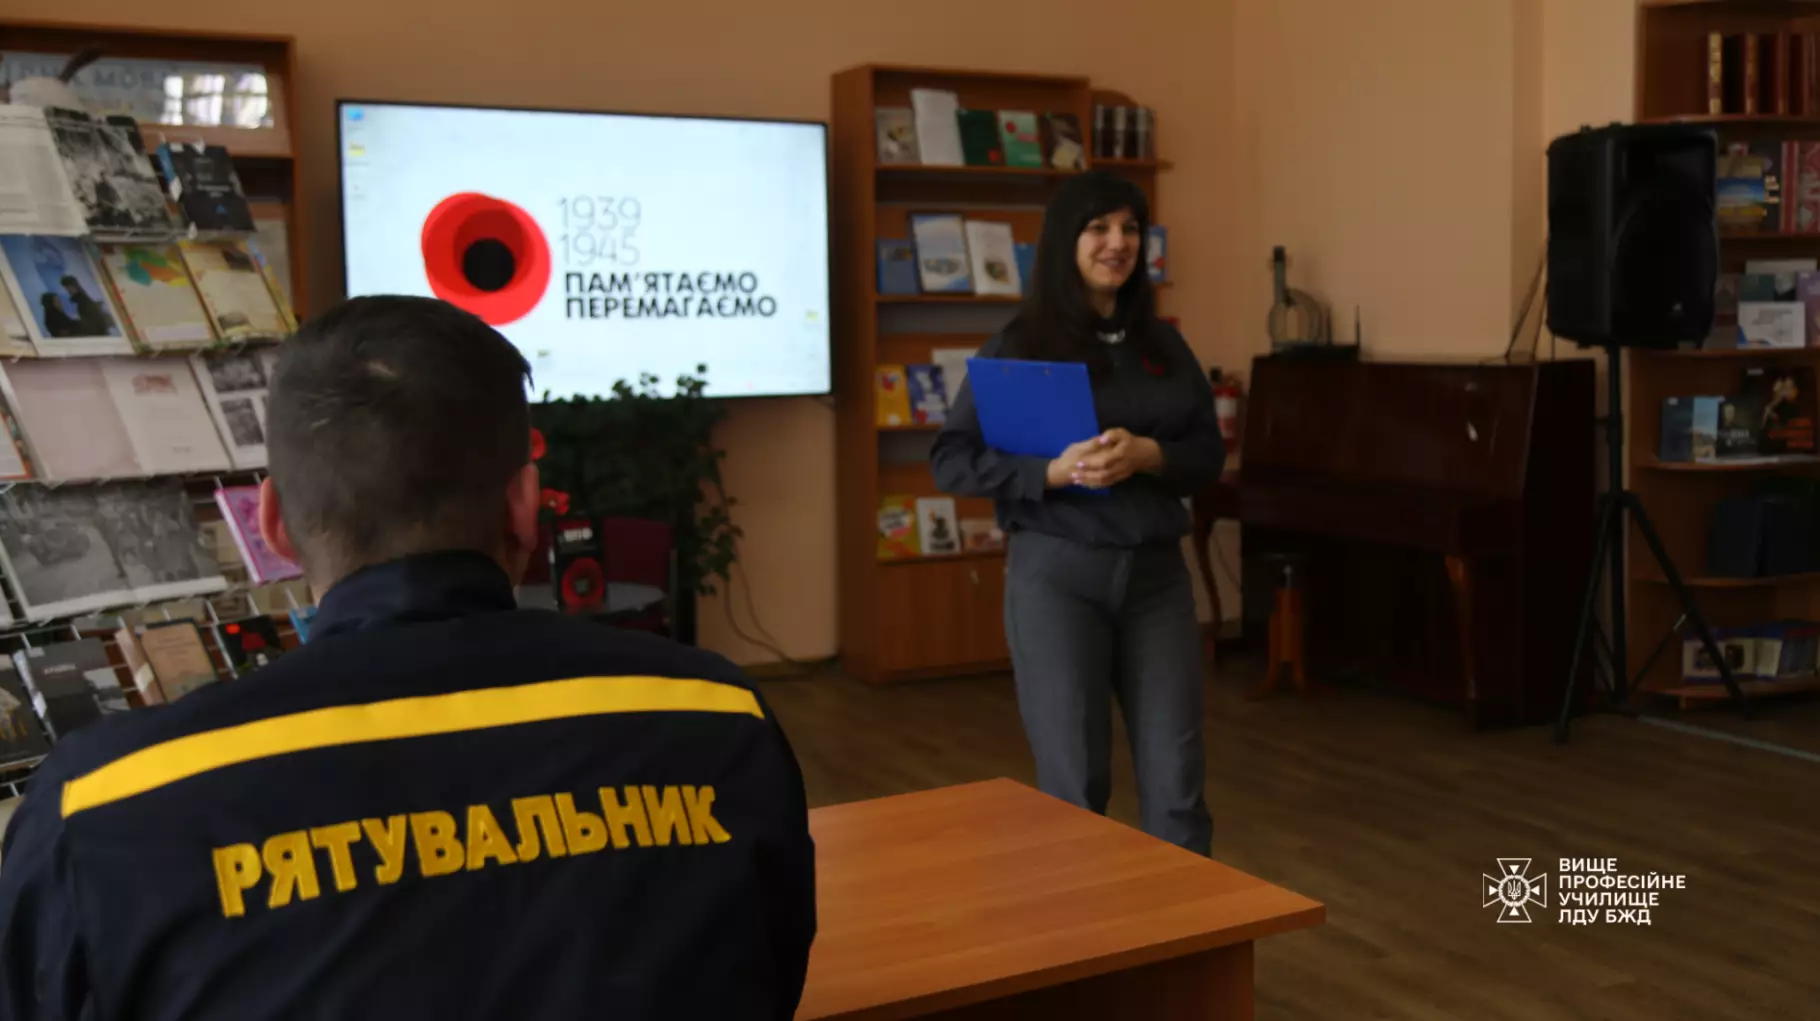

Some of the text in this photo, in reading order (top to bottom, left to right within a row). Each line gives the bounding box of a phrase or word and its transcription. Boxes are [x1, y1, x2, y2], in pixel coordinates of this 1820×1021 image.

[560, 195, 641, 231] 1939
[560, 231, 641, 266] 1945
[565, 271, 758, 294] ПАМ'ЯТАЄМО
[566, 295, 778, 319] ПЕРЕМАГАЄМО
[212, 785, 732, 918] РЯТУВАЛЬНИК
